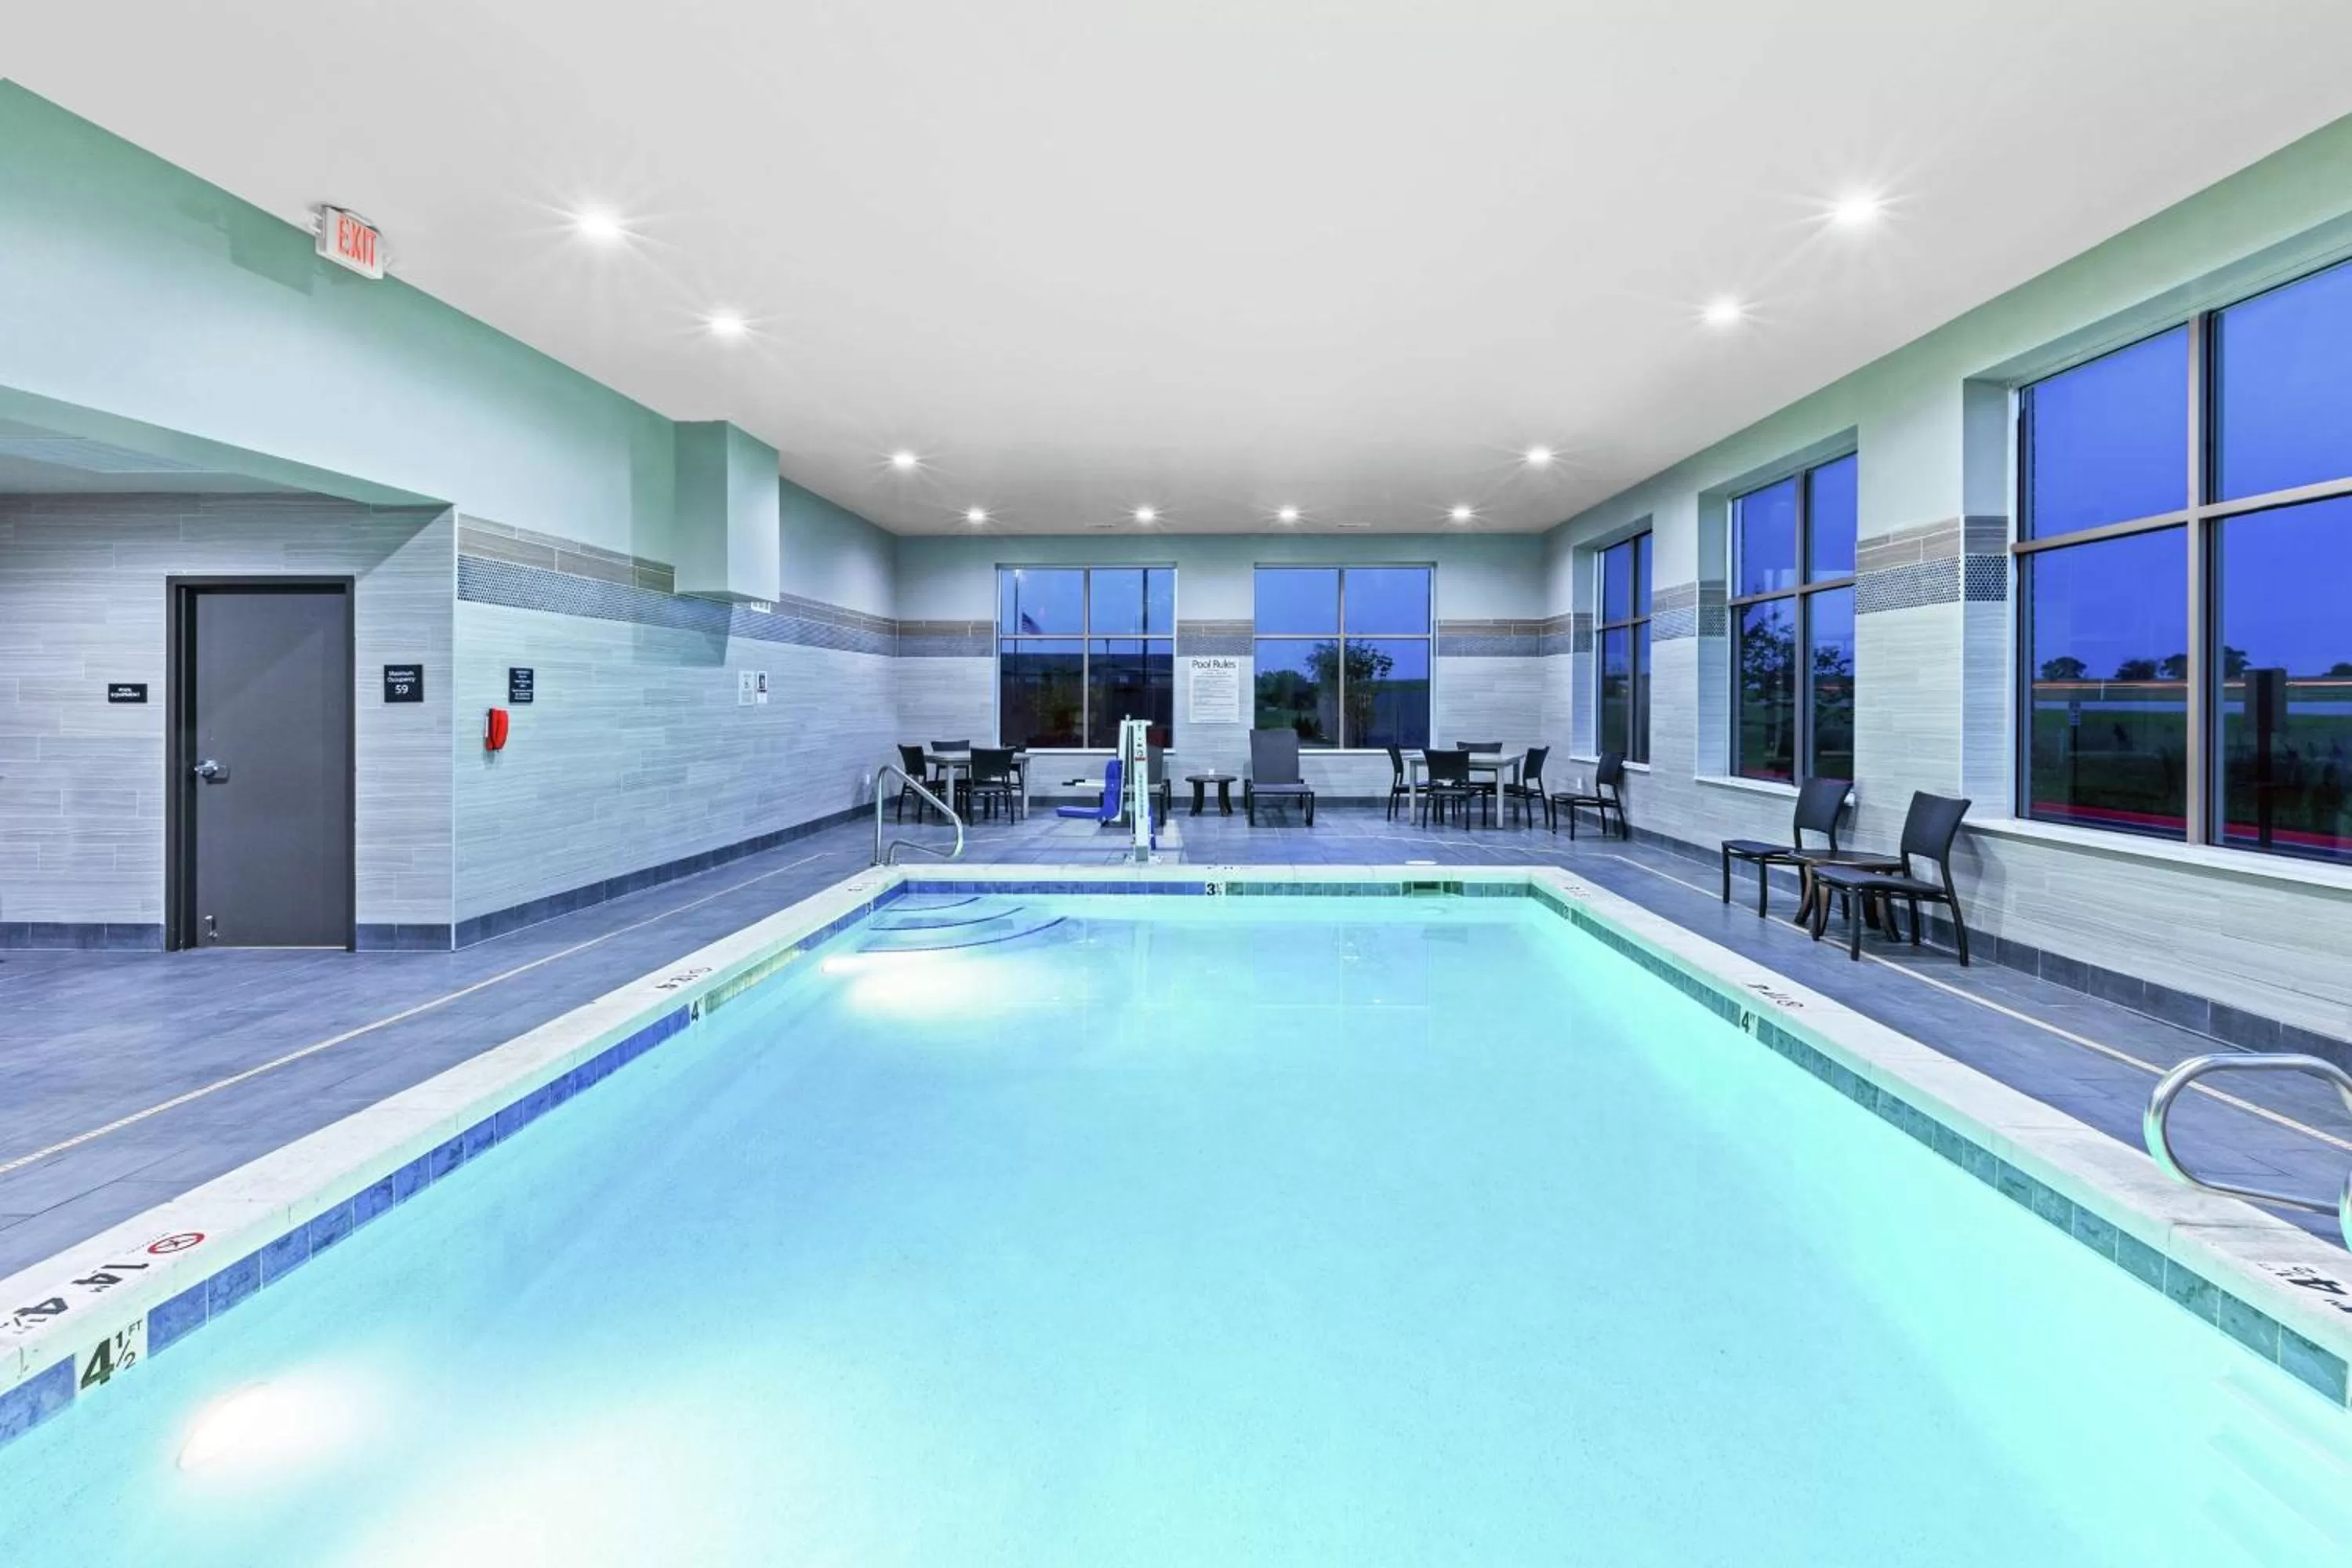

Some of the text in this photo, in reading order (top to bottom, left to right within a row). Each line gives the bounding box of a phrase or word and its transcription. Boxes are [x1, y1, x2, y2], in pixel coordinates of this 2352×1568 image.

[337, 216, 377, 269] EXIT
[1191, 659, 1236, 669] Pool Rules
[394, 684, 408, 694] 59
[1741, 1011, 1750, 1034] 4
[80, 1337, 115, 1390] 4
[128, 1318, 143, 1336] FT
